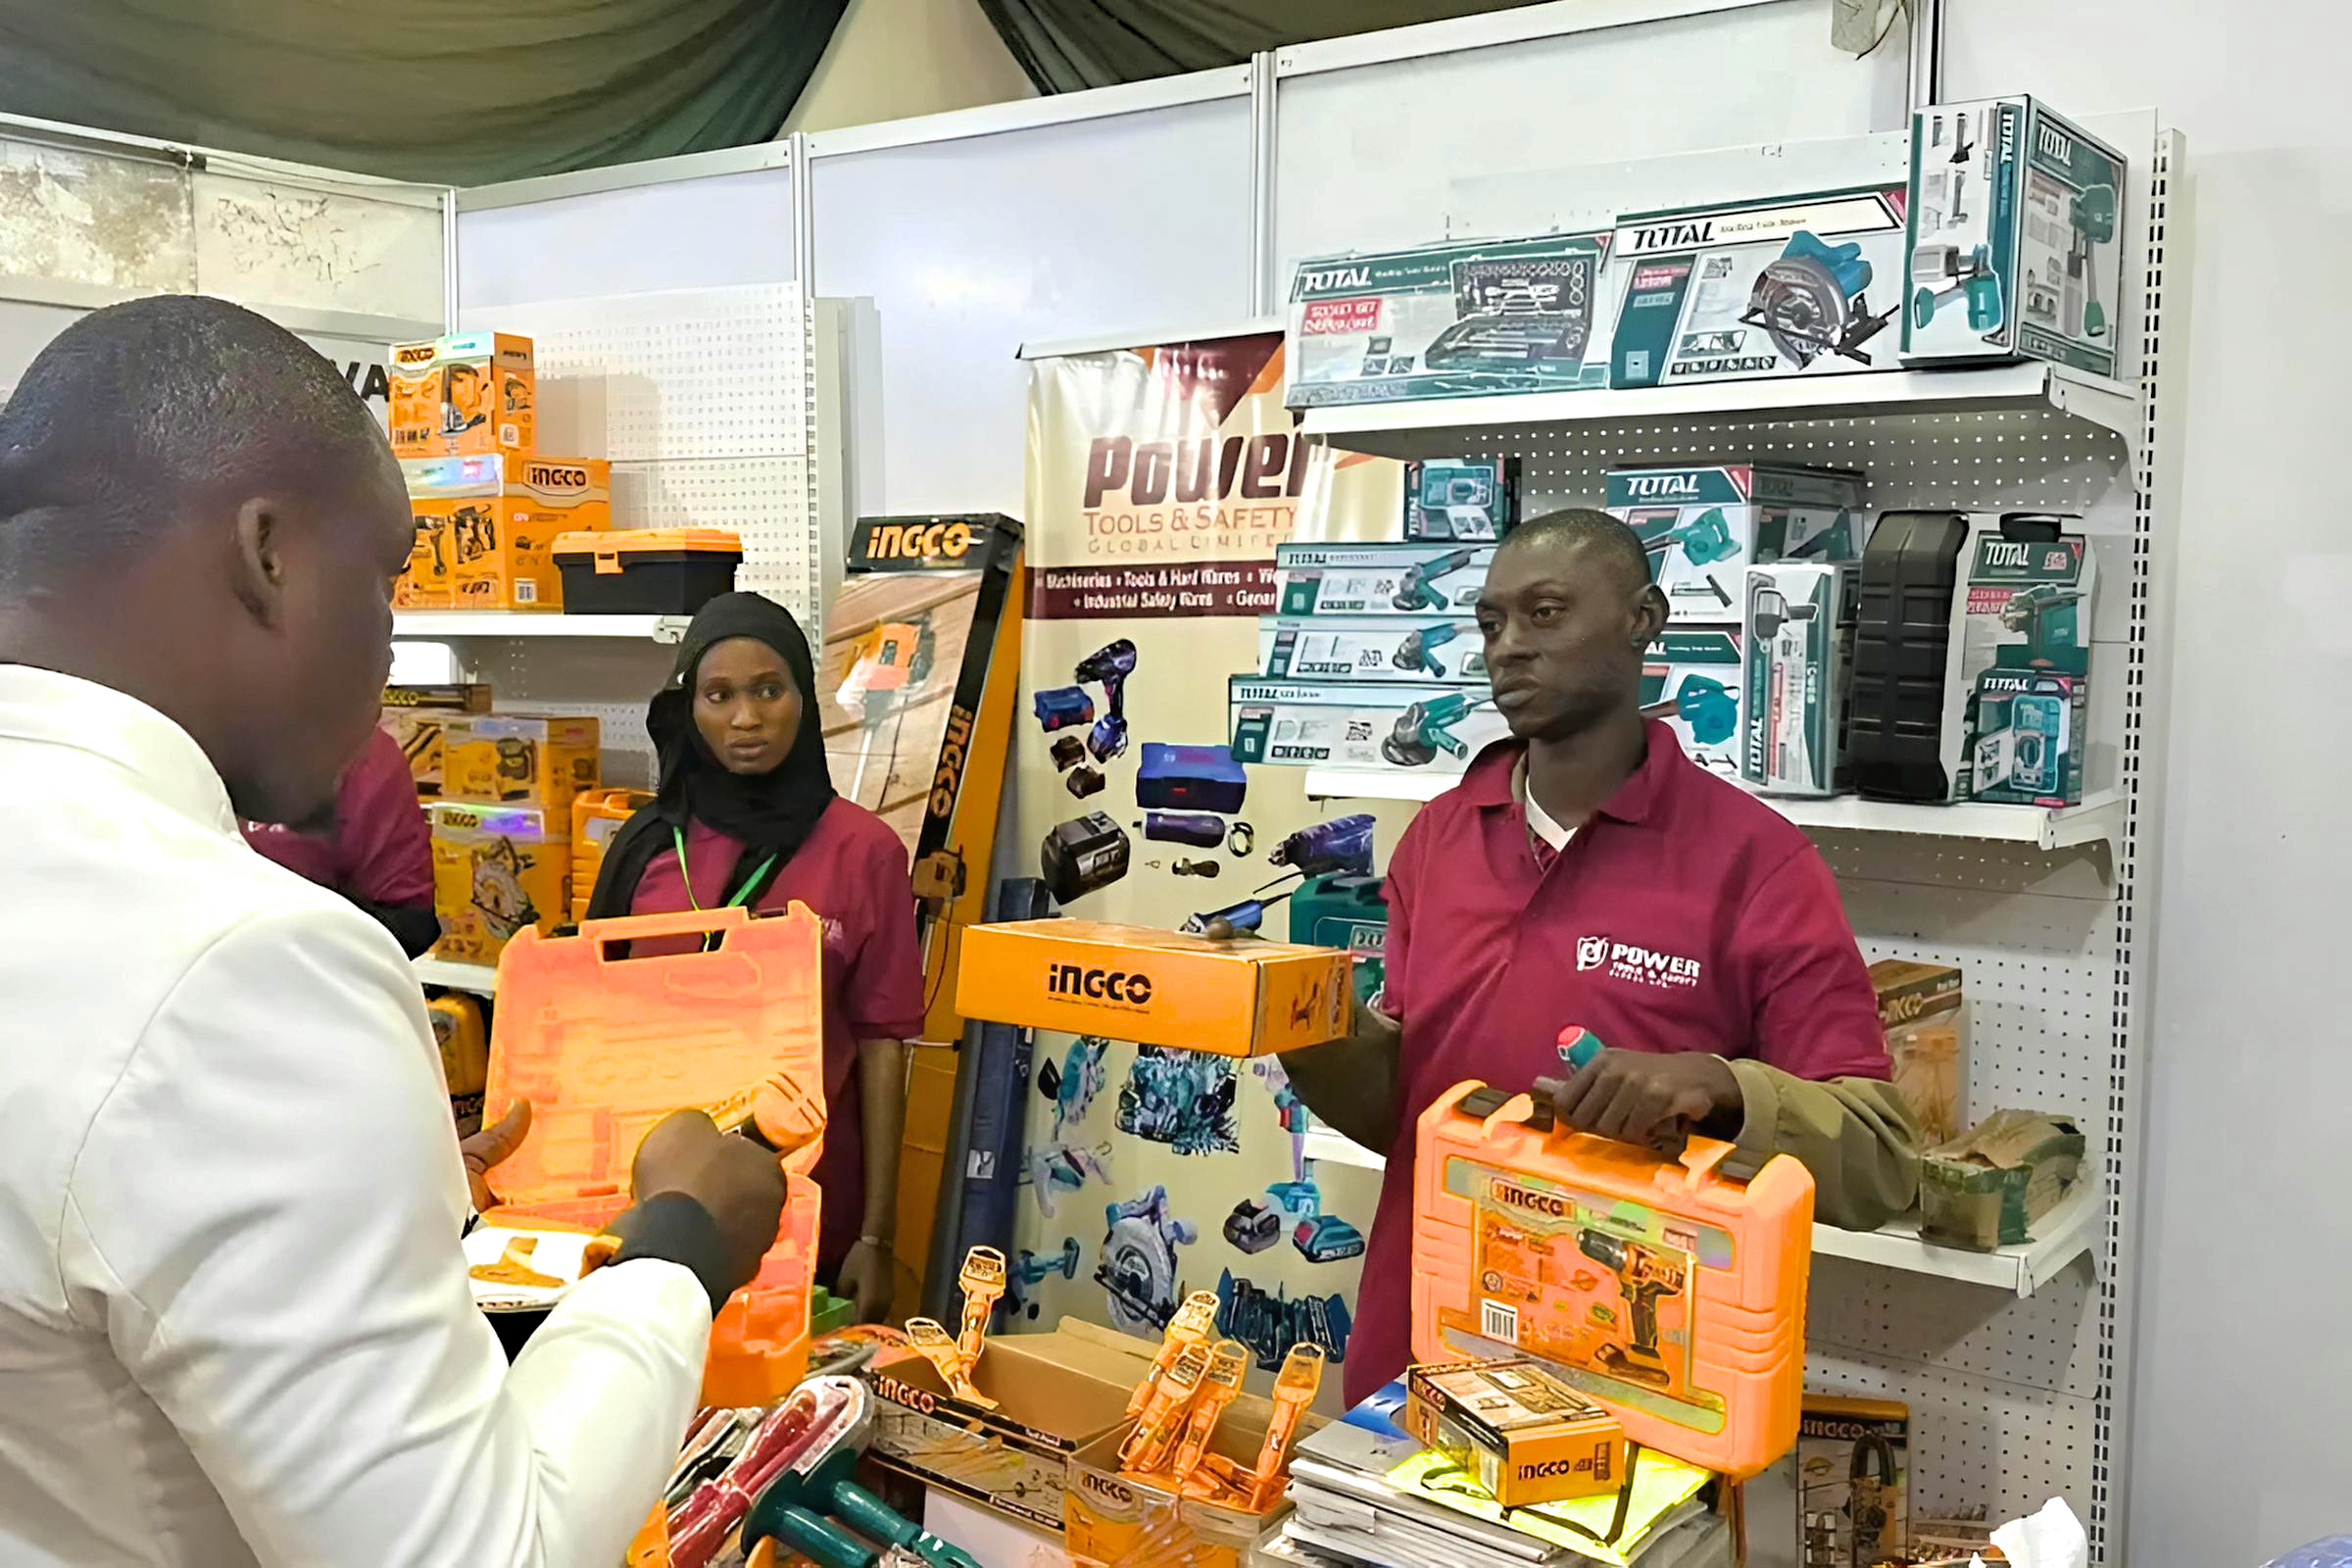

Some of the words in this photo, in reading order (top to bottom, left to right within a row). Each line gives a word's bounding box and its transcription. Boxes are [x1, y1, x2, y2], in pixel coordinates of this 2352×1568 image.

[1634, 221, 1715, 250] TOTAL
[1298, 267, 1372, 292] TOTAL
[532, 467, 586, 486] INGCO
[1627, 474, 1700, 496] TOTAL
[1084, 512, 1163, 536] TOOLS
[1170, 508, 1190, 531] &
[1195, 506, 1297, 530] SAFETY
[865, 521, 971, 559] INGCO
[1089, 537, 1179, 554] GLOBAL
[1985, 542, 2029, 565] TOTAL
[1749, 717, 1764, 772] TOTAL
[1611, 944, 1700, 977] POWER
[1050, 963, 1152, 1004] INGCO
[879, 1376, 935, 1414] INGCO
[1518, 1459, 1570, 1481] INGCO
